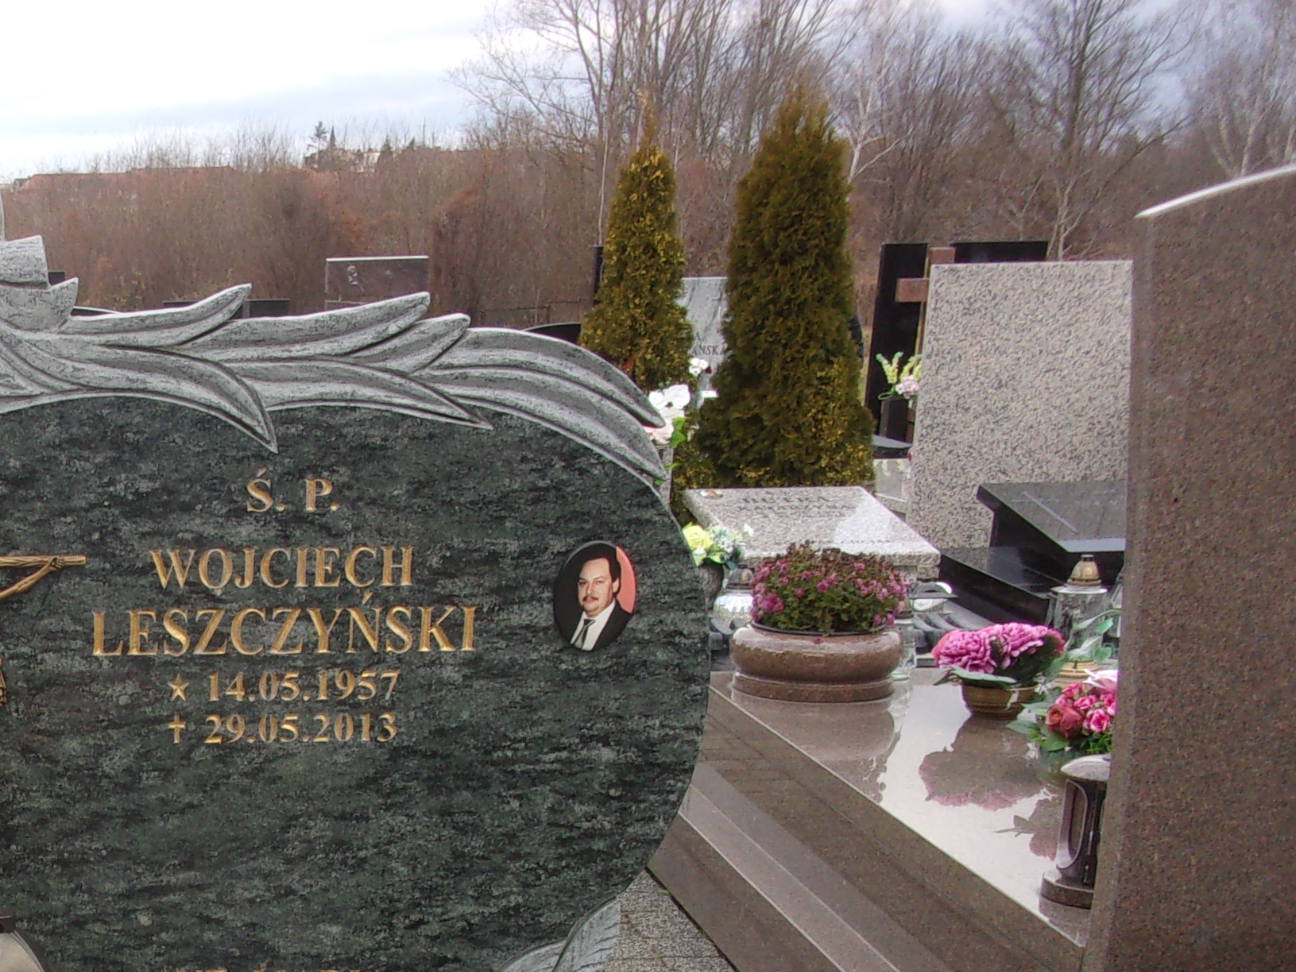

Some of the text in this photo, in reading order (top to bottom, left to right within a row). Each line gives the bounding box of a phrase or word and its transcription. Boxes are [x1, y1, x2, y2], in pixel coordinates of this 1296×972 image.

[246, 468, 337, 513] Ś. P.
[150, 545, 414, 589] WOJCIECH
[91, 591, 478, 657] LESZCZYŃSKI
[208, 669, 401, 702] 14.05.1957
[204, 713, 399, 745] 29.05.2013
